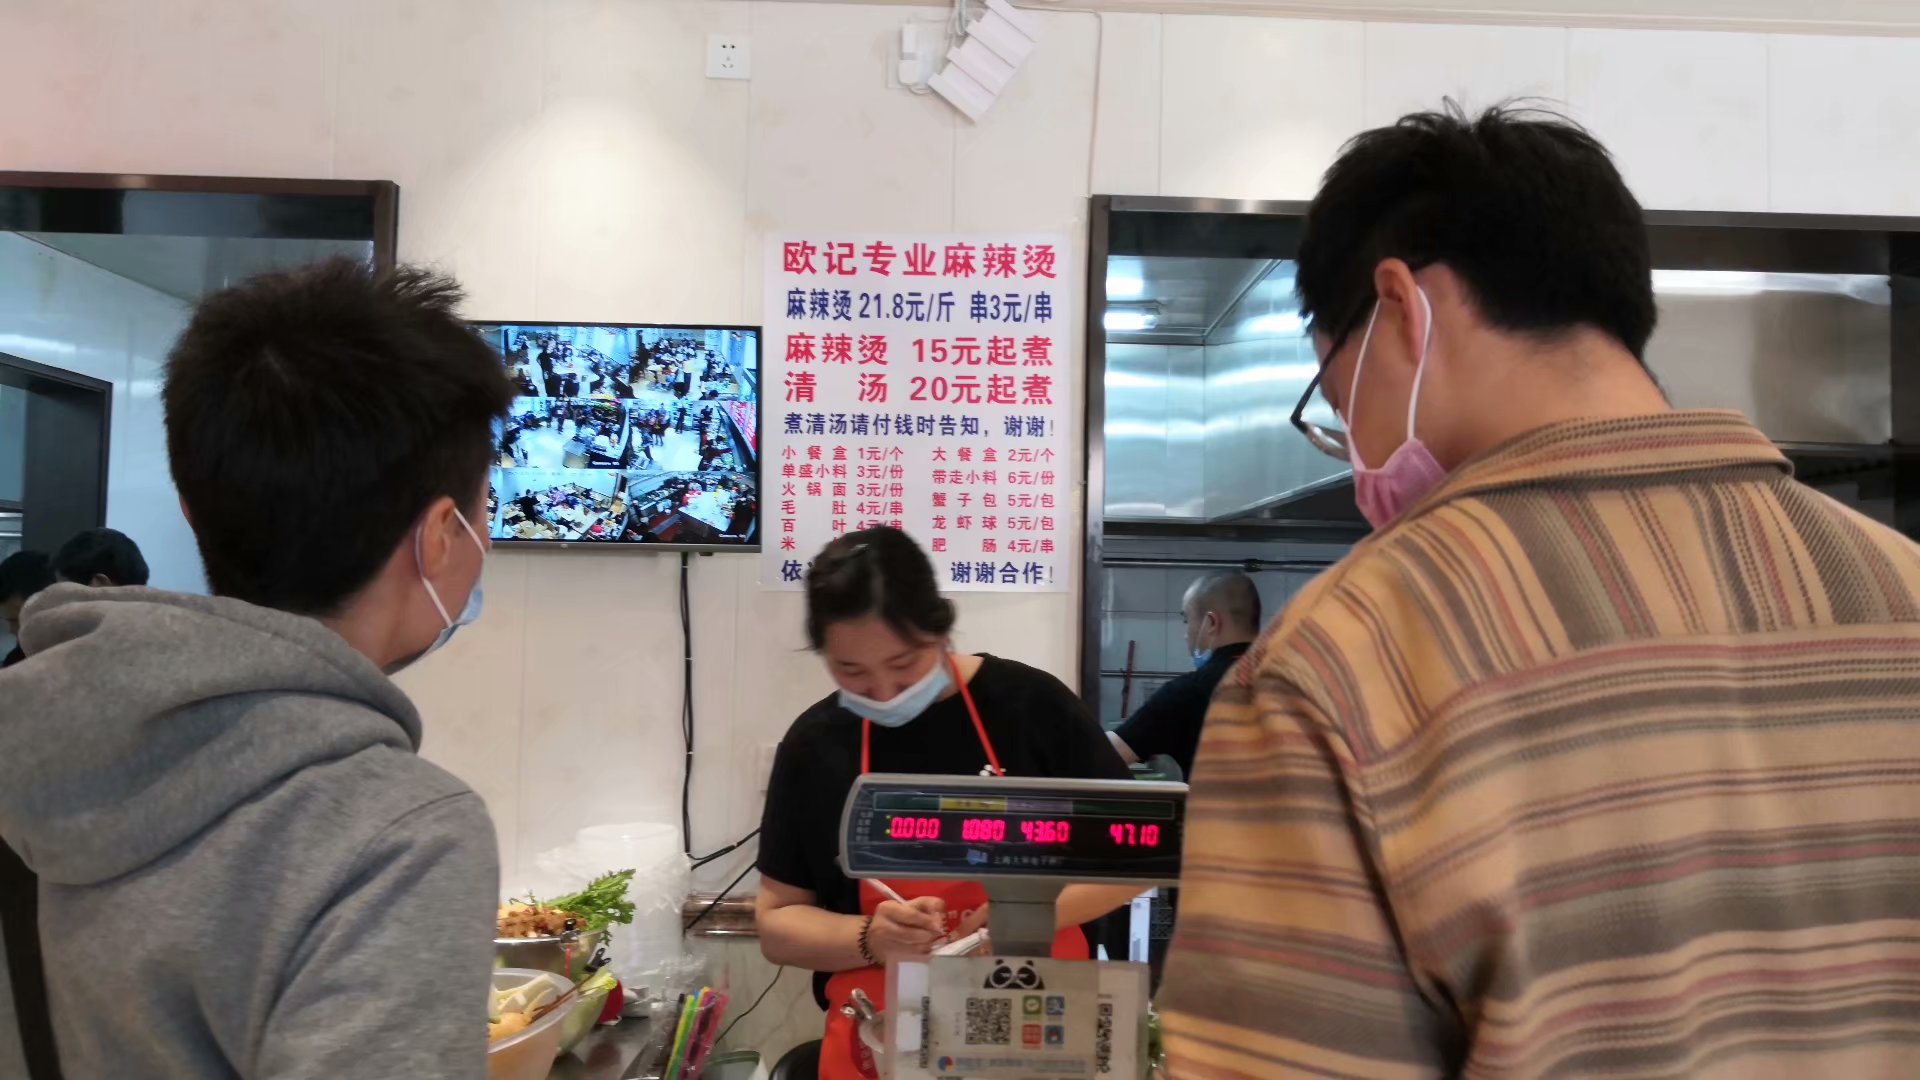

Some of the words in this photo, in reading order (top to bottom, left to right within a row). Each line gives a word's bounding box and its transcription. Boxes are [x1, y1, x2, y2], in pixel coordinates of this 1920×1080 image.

[783, 240, 1056, 279] 欧记专业麻辣烫
[787, 288, 954, 322] 麻辣烫21.8元/斤
[970, 290, 1053, 323] 串3元/串
[785, 332, 889, 366] 麻辣烫
[912, 336, 1054, 367] 15元起煮
[909, 373, 1054, 406] 20元起煮
[782, 445, 848, 461] 小餐盒
[859, 447, 903, 462] 1元/个
[932, 447, 997, 462] 大餐盒
[1008, 449, 1055, 463] 2元/个
[782, 464, 848, 479] 单盛小料
[857, 465, 904, 480] 3元/份
[933, 470, 998, 485] 带走小料
[1008, 472, 1055, 485] 6元/份
[782, 482, 847, 497] 火锅面
[857, 483, 904, 498] 3元/份
[857, 501, 904, 516] 4元/串
[932, 492, 996, 510] 蟹子包
[1008, 493, 1055, 509] 5元/包
[932, 515, 998, 531] 龙虾球
[1008, 516, 1056, 530] 5元/包
[1008, 539, 1055, 553] 4元/串
